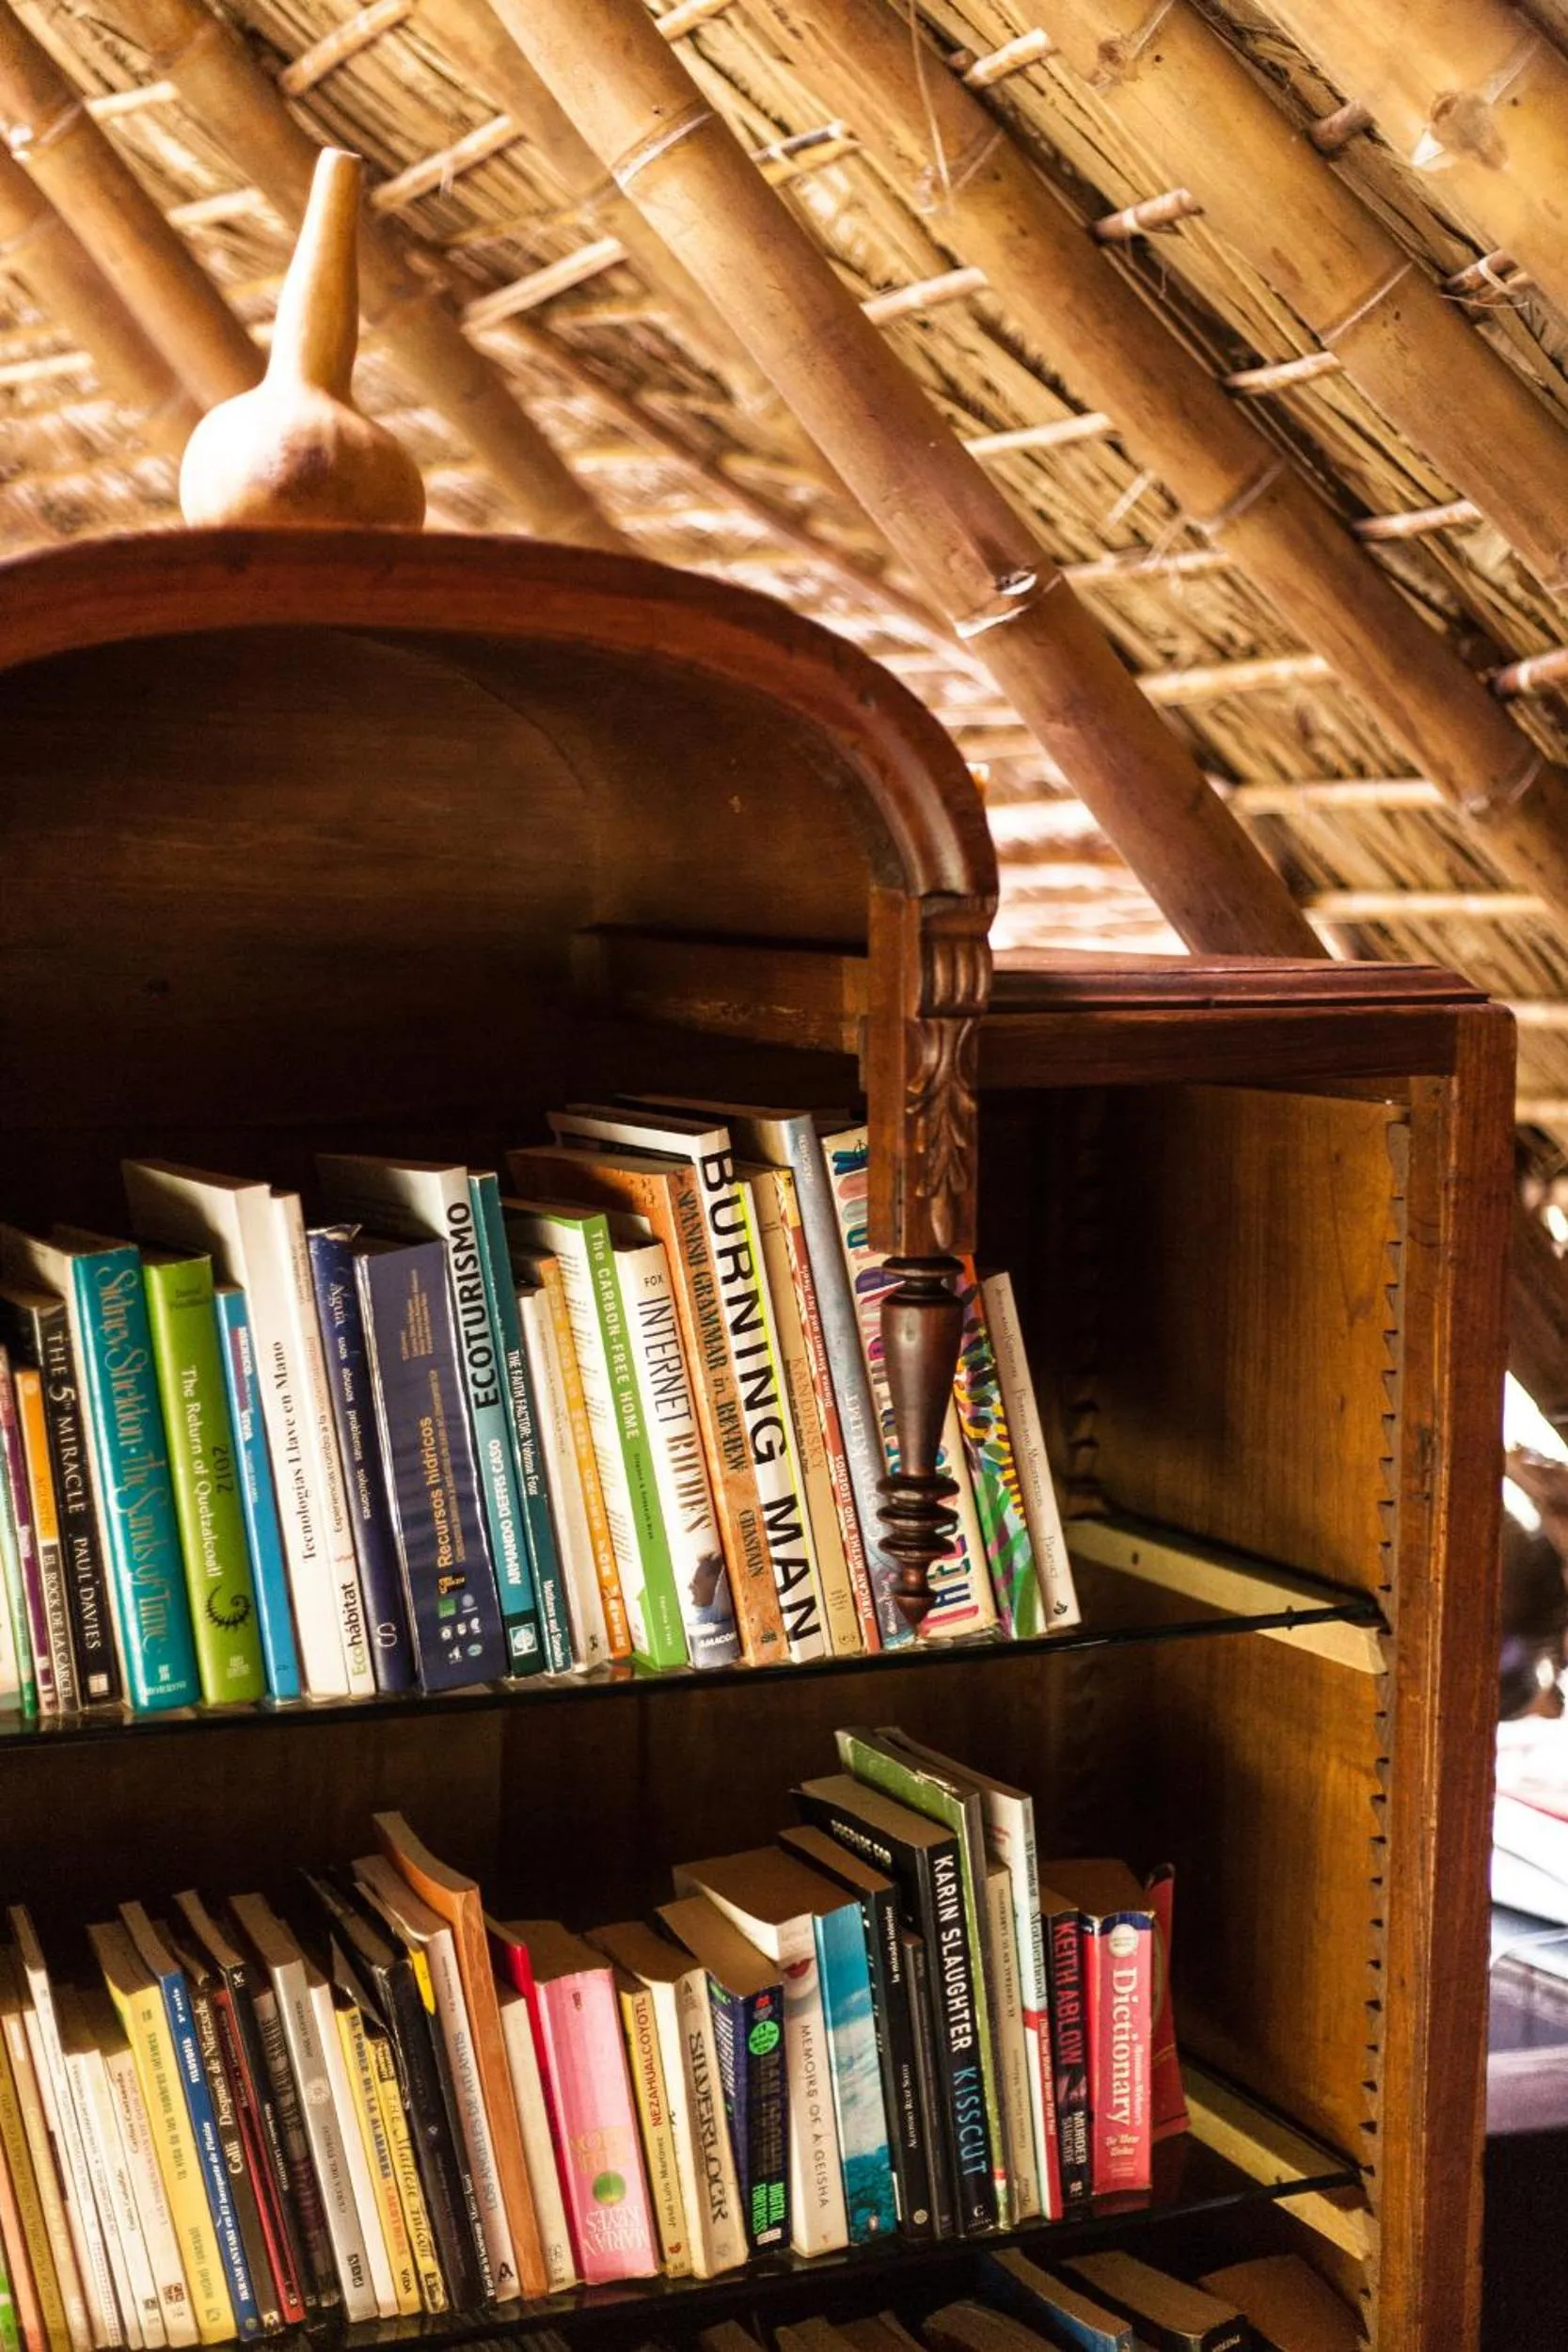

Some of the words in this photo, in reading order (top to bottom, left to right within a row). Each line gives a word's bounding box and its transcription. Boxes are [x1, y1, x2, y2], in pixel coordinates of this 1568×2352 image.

[587, 1229, 609, 1262] The
[675, 1187, 711, 1266] SPANISH
[94, 1264, 145, 1343] Sidney
[444, 1201, 500, 1409] ECOTURISMO
[644, 1273, 664, 1288] FOX
[593, 1266, 632, 1385] CARBON-FREE
[689, 1269, 729, 1371] GRAMMAR
[45, 1330, 68, 1376] THE
[267, 1340, 291, 1391] Mano
[335, 1336, 349, 1359] usos
[505, 1350, 521, 1368] THE
[103, 1343, 156, 1446] Sheldon
[181, 1364, 198, 1398] The
[278, 1393, 294, 1413] en
[339, 1367, 356, 1402] abusos
[509, 1369, 526, 1398] FAITH
[699, 1149, 789, 1466] BURNING
[758, 1495, 822, 1643] MAN
[711, 1375, 732, 1394] in
[187, 1402, 203, 1455] Return
[344, 1409, 365, 1461] problemas
[513, 1398, 532, 1438] FACTOR:
[617, 1390, 641, 1439] HOME
[638, 1294, 693, 1424] INTERNET
[666, 1430, 711, 1534] RICHES
[712, 1400, 751, 1473] REVIEW
[791, 1356, 823, 1471] KANDINSKY
[842, 1391, 868, 1456] KLIMT
[56, 1415, 86, 1514] MIRACLE
[280, 1417, 303, 1463] Llave
[485, 1438, 505, 1473] CASO
[117, 1449, 165, 1489] The
[193, 1459, 208, 1475] of
[211, 1444, 235, 1494] 2012
[833, 1454, 851, 1502] LEGENDS
[355, 1468, 374, 1519] soluciones
[844, 1505, 856, 1529] AND
[120, 1487, 168, 1561] Sands
[194, 1480, 223, 1578] Quetzalcoatl
[426, 1487, 453, 1567] Recursos
[736, 1508, 769, 1579] CHASTAIN
[41, 1553, 56, 1569] EL
[72, 1536, 92, 1579] PAUL
[128, 1557, 169, 1588] of
[498, 1519, 524, 1585] ARMANDO
[848, 1533, 863, 1569] MYTHS
[43, 1572, 62, 1608] ROCK
[856, 1572, 874, 1619] AFRICAN
[49, 1611, 64, 1629] DE
[53, 1630, 67, 1650] LA
[79, 1586, 102, 1649] DAVIES
[134, 1585, 177, 1653] Time
[337, 1580, 369, 1677] Ecohábitat
[932, 1853, 960, 1923] KARIN
[882, 1905, 896, 1940] interior
[887, 1940, 900, 1972] mirada
[1027, 1910, 1048, 1999] Motherhood
[1051, 1919, 1080, 1986] KEITH
[941, 1928, 974, 2053] SLAUGHTER
[1003, 1967, 1014, 2004] GENERAL
[193, 1997, 218, 2058] Nietzsche
[347, 2012, 360, 2028] EL
[1054, 1989, 1085, 2066] ABLOW
[205, 2058, 221, 2075] de
[351, 2032, 370, 2074] PODER
[450, 2030, 477, 2095] ATLANTIS
[635, 1995, 663, 2128] NEZAHUALCOYOTL
[799, 2024, 816, 2098] MEMOIRS
[1106, 1967, 1138, 2125] Dictionary
[112, 2071, 134, 2122] Castaneda
[206, 2075, 233, 2126] Después
[360, 2076, 373, 2092] DE
[364, 2096, 378, 2114] LA
[385, 2093, 402, 2122] THE
[464, 2094, 481, 2117] DE
[123, 2122, 140, 2154] Carlos
[685, 2029, 729, 2224] SILVERLOCK
[809, 2104, 819, 2123] OF
[952, 2065, 987, 2176] KISSCUT
[1071, 2110, 1087, 2164] MURDER
[223, 2141, 241, 2174] Colli
[367, 2116, 393, 2180] ALABANZA
[388, 2125, 421, 2199] Maltese
[1059, 2116, 1075, 2164] SUICIDE
[480, 2181, 499, 2211] LOS
[662, 2182, 673, 2202] Luis
[767, 2182, 785, 2223] DIGITAL
[812, 2149, 829, 2208] GEISHA
[408, 2206, 435, 2259] Falcon
[584, 2205, 640, 2233] KEYES
[751, 2184, 768, 2234] FORTRESS
[224, 2228, 244, 2265] ANTAKI
[582, 2228, 649, 2259] MARIAN
